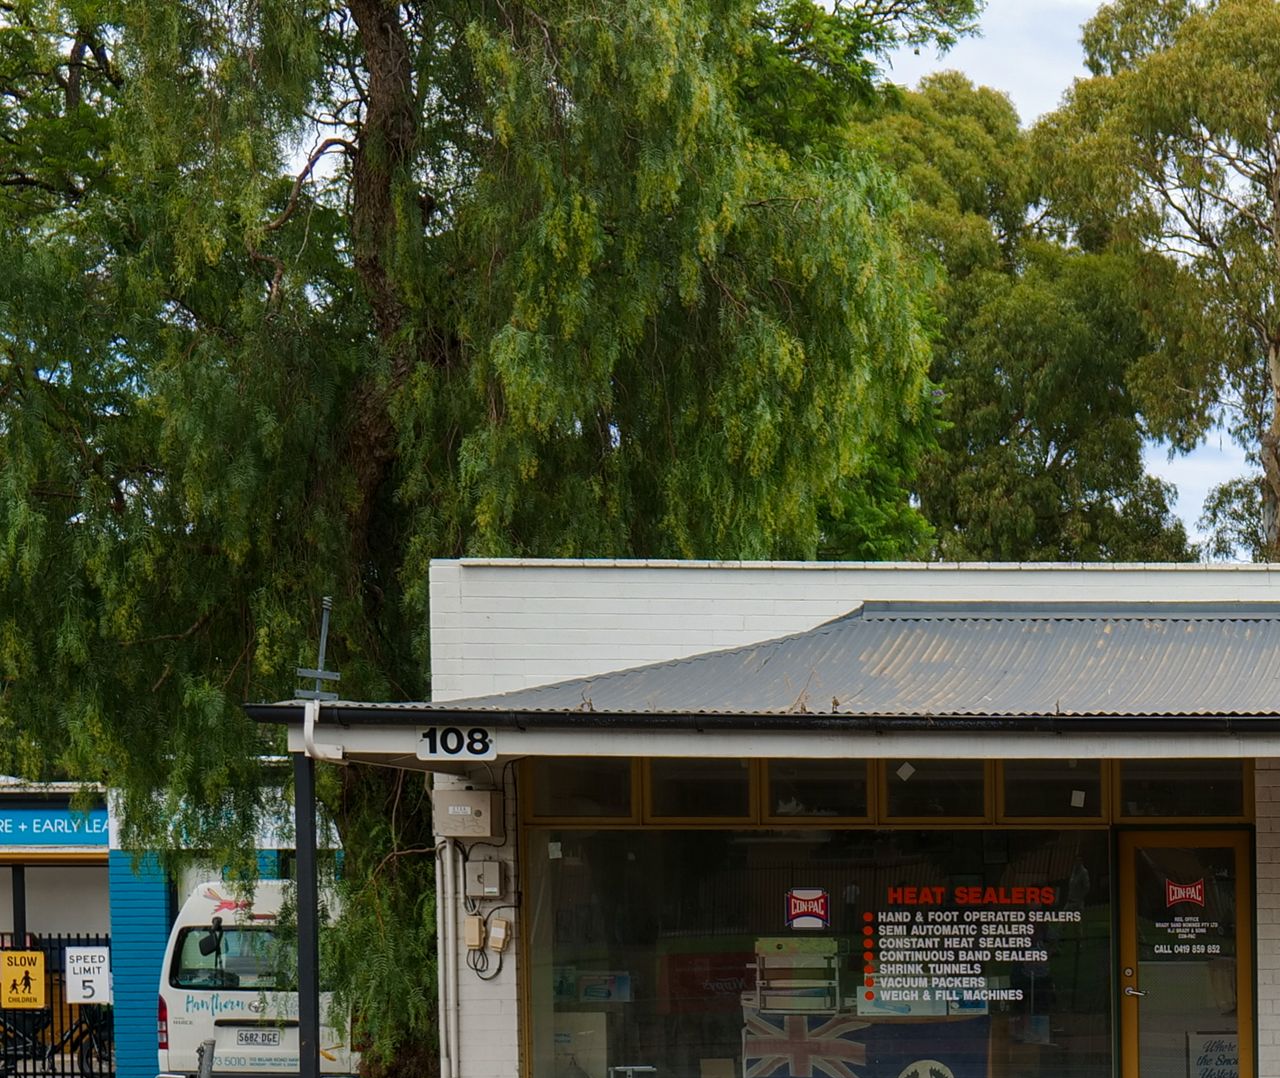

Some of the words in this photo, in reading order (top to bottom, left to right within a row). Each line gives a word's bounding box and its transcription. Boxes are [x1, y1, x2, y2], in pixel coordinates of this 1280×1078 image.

[422, 727, 490, 755] 108
[33, 819, 81, 833] EARLY
[888, 886, 945, 905] HEAT
[954, 886, 1056, 905] SEALERS
[1169, 884, 1202, 902] CON-PAC
[791, 898, 825, 916] CON-PAC
[878, 912, 911, 922] HAND
[915, 912, 924, 922] &
[928, 912, 959, 922] FOOT
[964, 912, 1026, 922] OPERATED
[1029, 912, 1081, 922] SEALERS
[878, 924, 907, 936] SEMI
[911, 924, 977, 936] AUTOMATIC
[981, 924, 1034, 936] SEALERS
[879, 938, 940, 949] CONSTANT
[944, 938, 974, 949] HEAT
[979, 938, 1031, 949] SEALERS
[1154, 944, 1172, 954] CALL
[1174, 944, 1190, 954] 0419
[7, 956, 37, 967] SLOW
[69, 955, 106, 964] SPEED
[880, 951, 954, 962] CONTINUOUS
[959, 951, 991, 962] BAND
[995, 951, 1048, 962] SEALERS
[72, 966, 102, 975] LIMIT
[880, 964, 923, 975] SHRINK
[928, 964, 981, 975] TUNNELS
[880, 977, 928, 988] VACUUM
[932, 977, 985, 988] PACKERS
[81, 979, 96, 999] 5
[880, 990, 919, 1001] WEIGH
[923, 990, 931, 1001] &
[936, 990, 959, 1001] FILL
[964, 990, 1023, 1001] MACHINES
[224, 1056, 246, 1067] 5010
[1196, 1054, 1213, 1066] the
